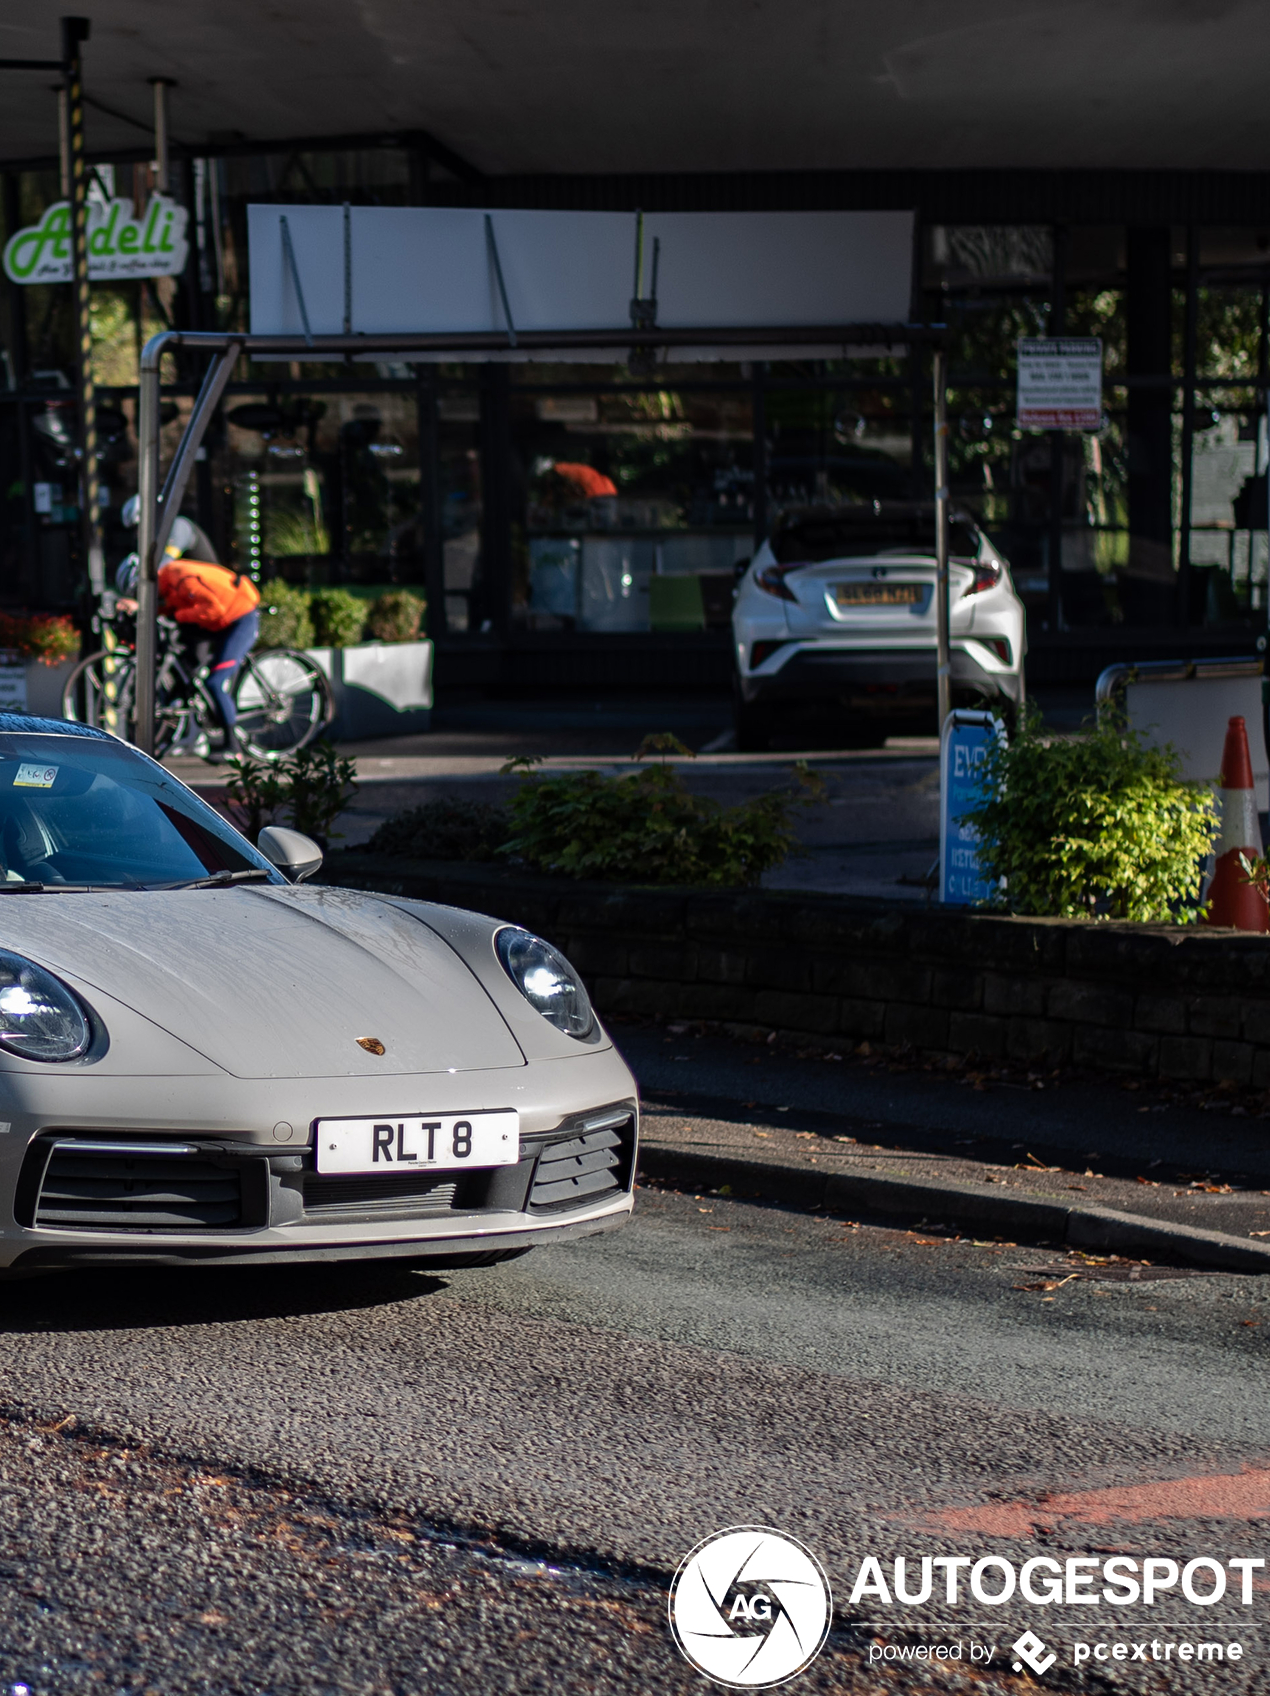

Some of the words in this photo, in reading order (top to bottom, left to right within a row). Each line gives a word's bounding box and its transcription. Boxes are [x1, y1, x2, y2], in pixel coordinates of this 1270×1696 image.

[9, 202, 174, 278] Adeli
[372, 1122, 441, 1162] RLT
[452, 1120, 472, 1158] 8
